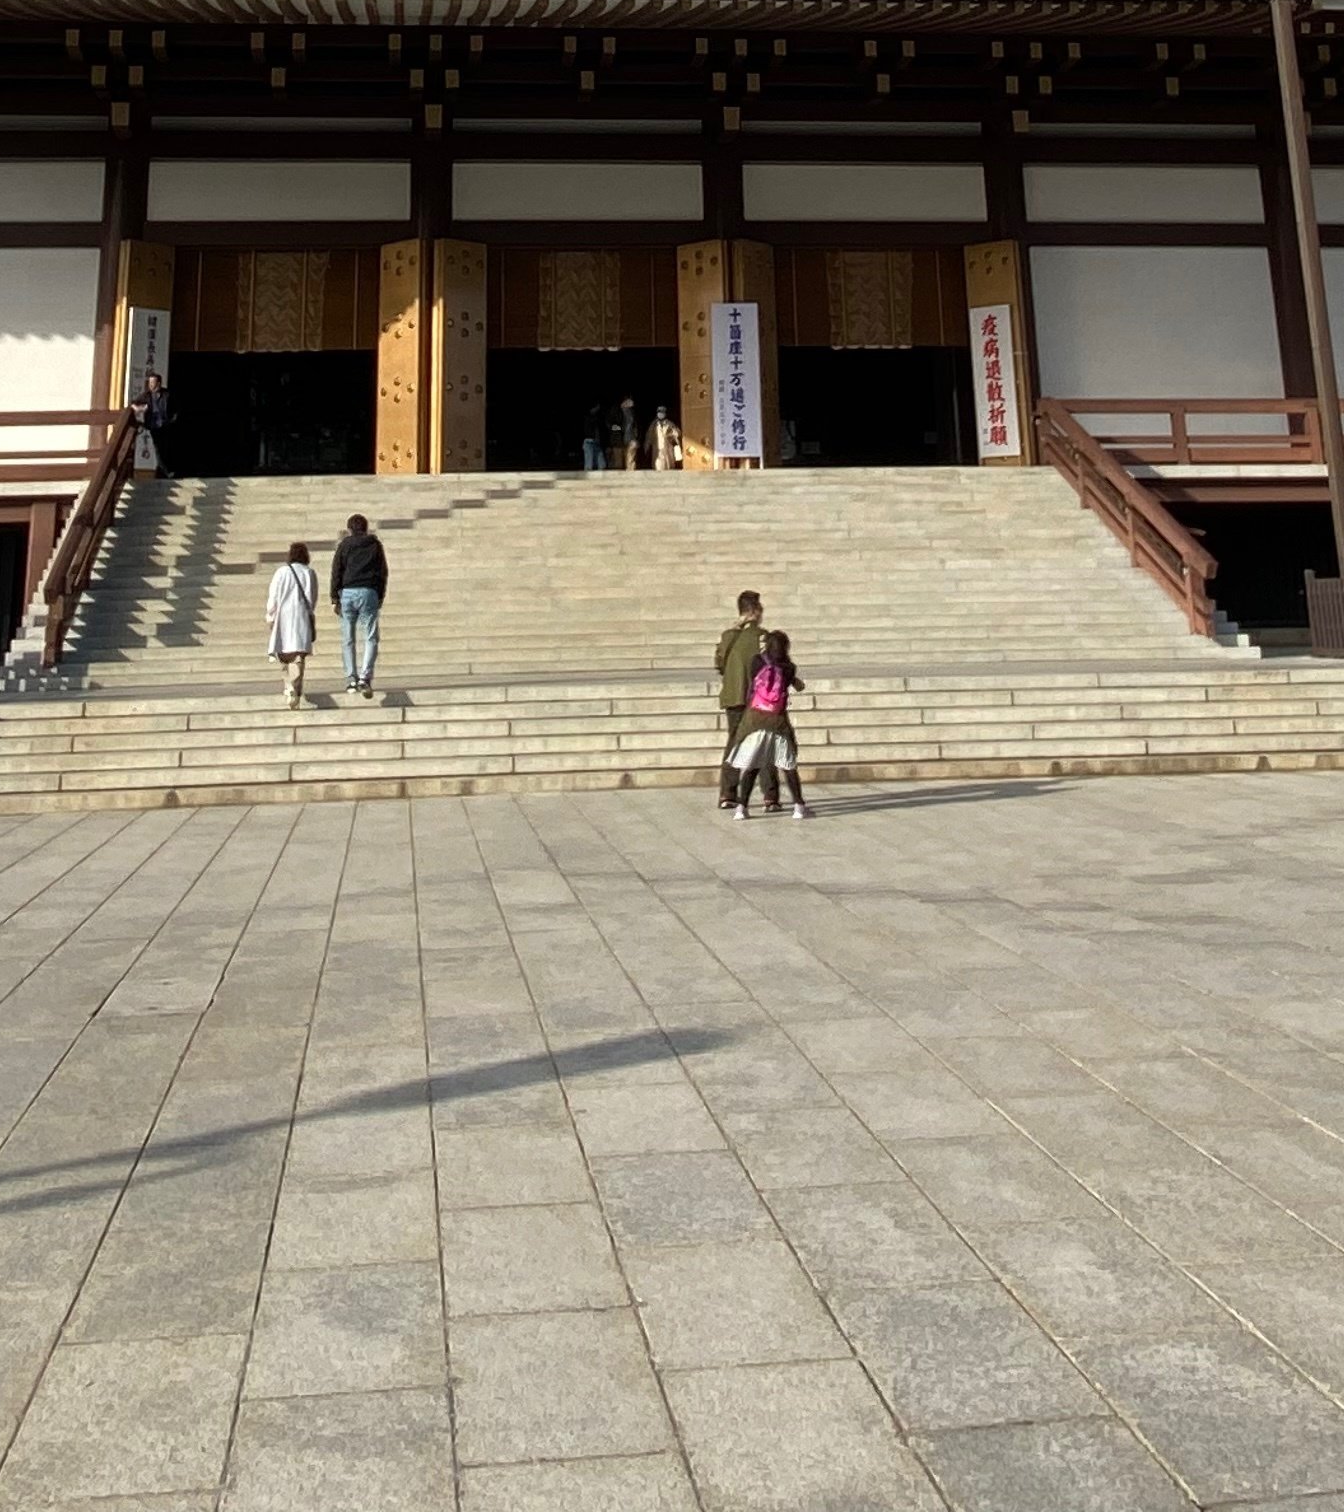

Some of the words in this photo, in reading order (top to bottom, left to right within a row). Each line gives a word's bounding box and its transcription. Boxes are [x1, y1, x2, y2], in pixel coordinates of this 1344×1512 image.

[981, 314, 1008, 446] 疫病退散祈願
